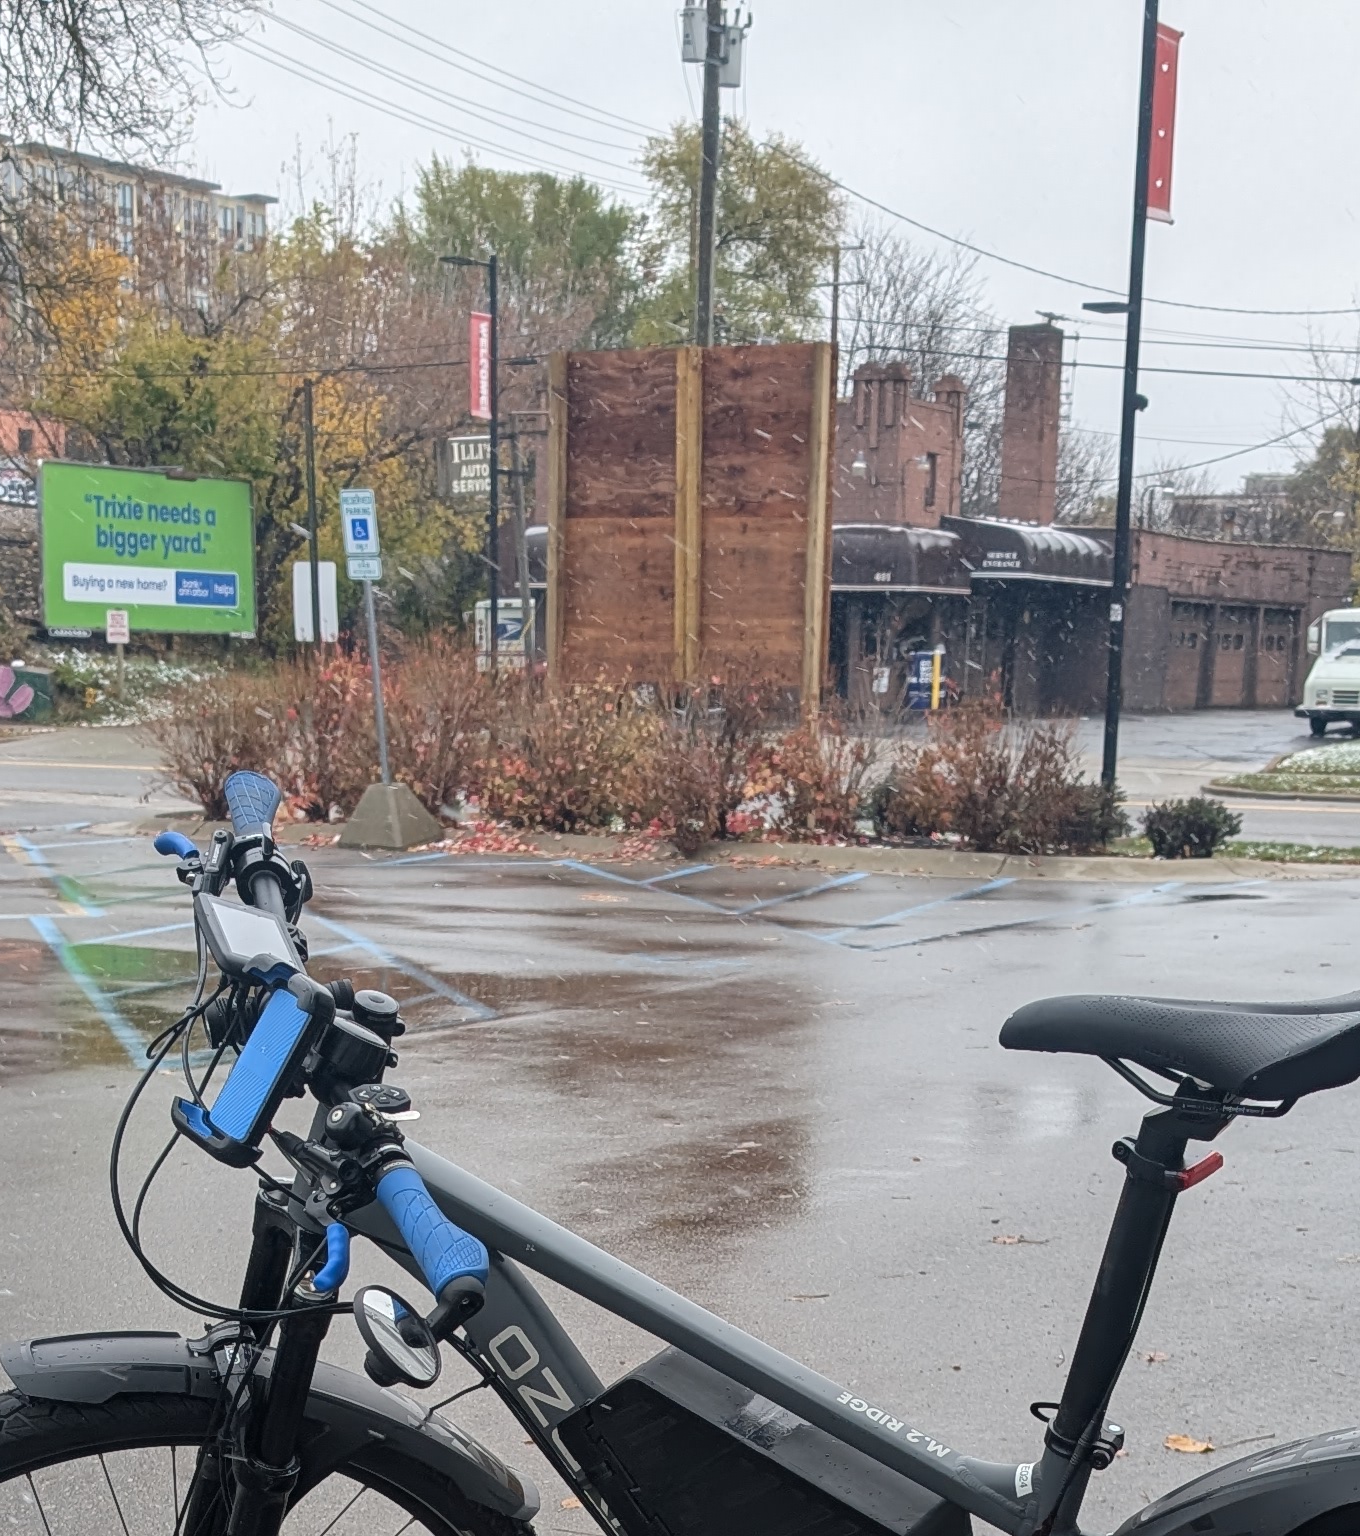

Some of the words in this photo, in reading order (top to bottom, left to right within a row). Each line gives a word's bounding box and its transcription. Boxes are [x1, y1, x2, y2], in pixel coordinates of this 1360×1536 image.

[460, 464, 489, 478] AUTO
[451, 479, 492, 493] SERVIC
[148, 503, 201, 525] needs
[205, 509, 216, 526] a
[96, 524, 157, 558] bigger
[72, 575, 105, 591] Buying
[107, 579, 114, 588] a
[115, 580, 134, 589] new
[137, 578, 168, 591] home?
[836, 1391, 905, 1433] RIDGE
[906, 1428, 952, 1458] M.2
[1018, 1464, 1031, 1489] E024
